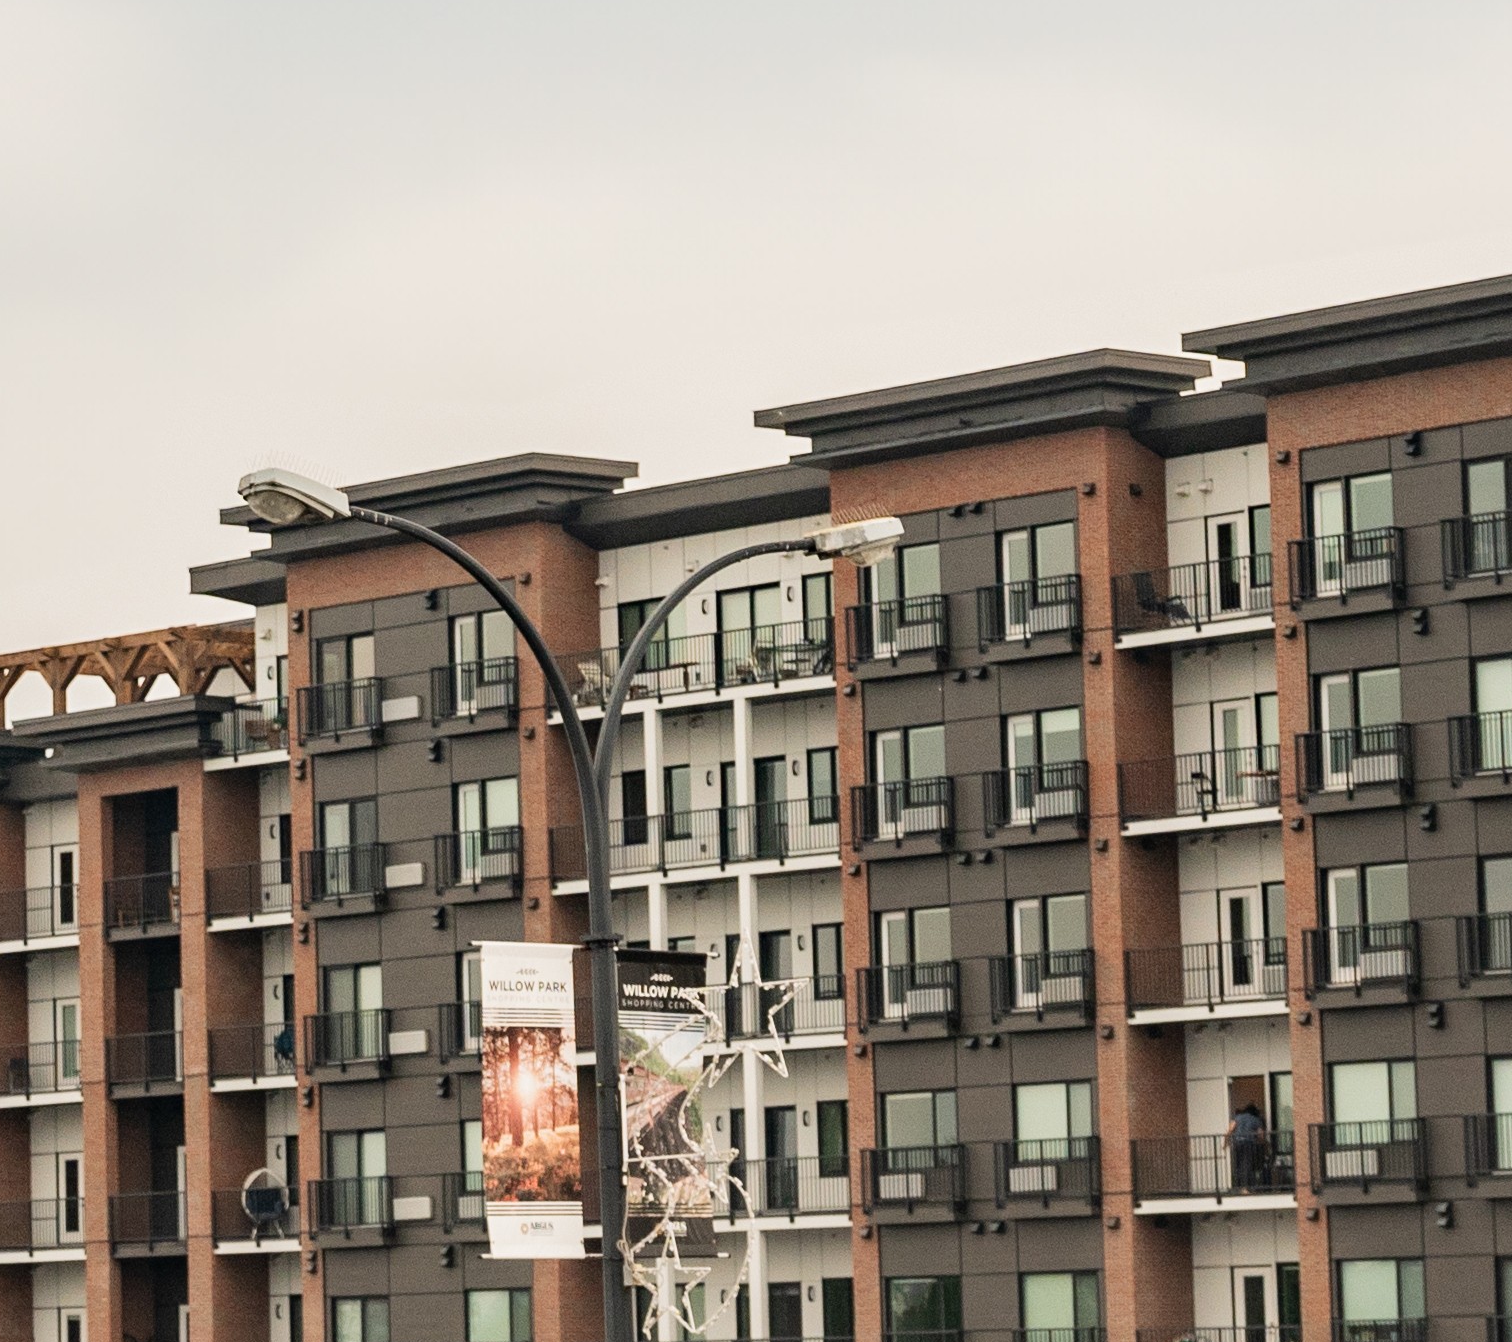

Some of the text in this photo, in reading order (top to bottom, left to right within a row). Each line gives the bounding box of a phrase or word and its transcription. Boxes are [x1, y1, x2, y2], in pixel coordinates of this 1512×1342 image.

[488, 980, 568, 992] WILLOW PARK
[623, 984, 669, 998] WILLOW
[622, 999, 664, 1009] SHOPPING
